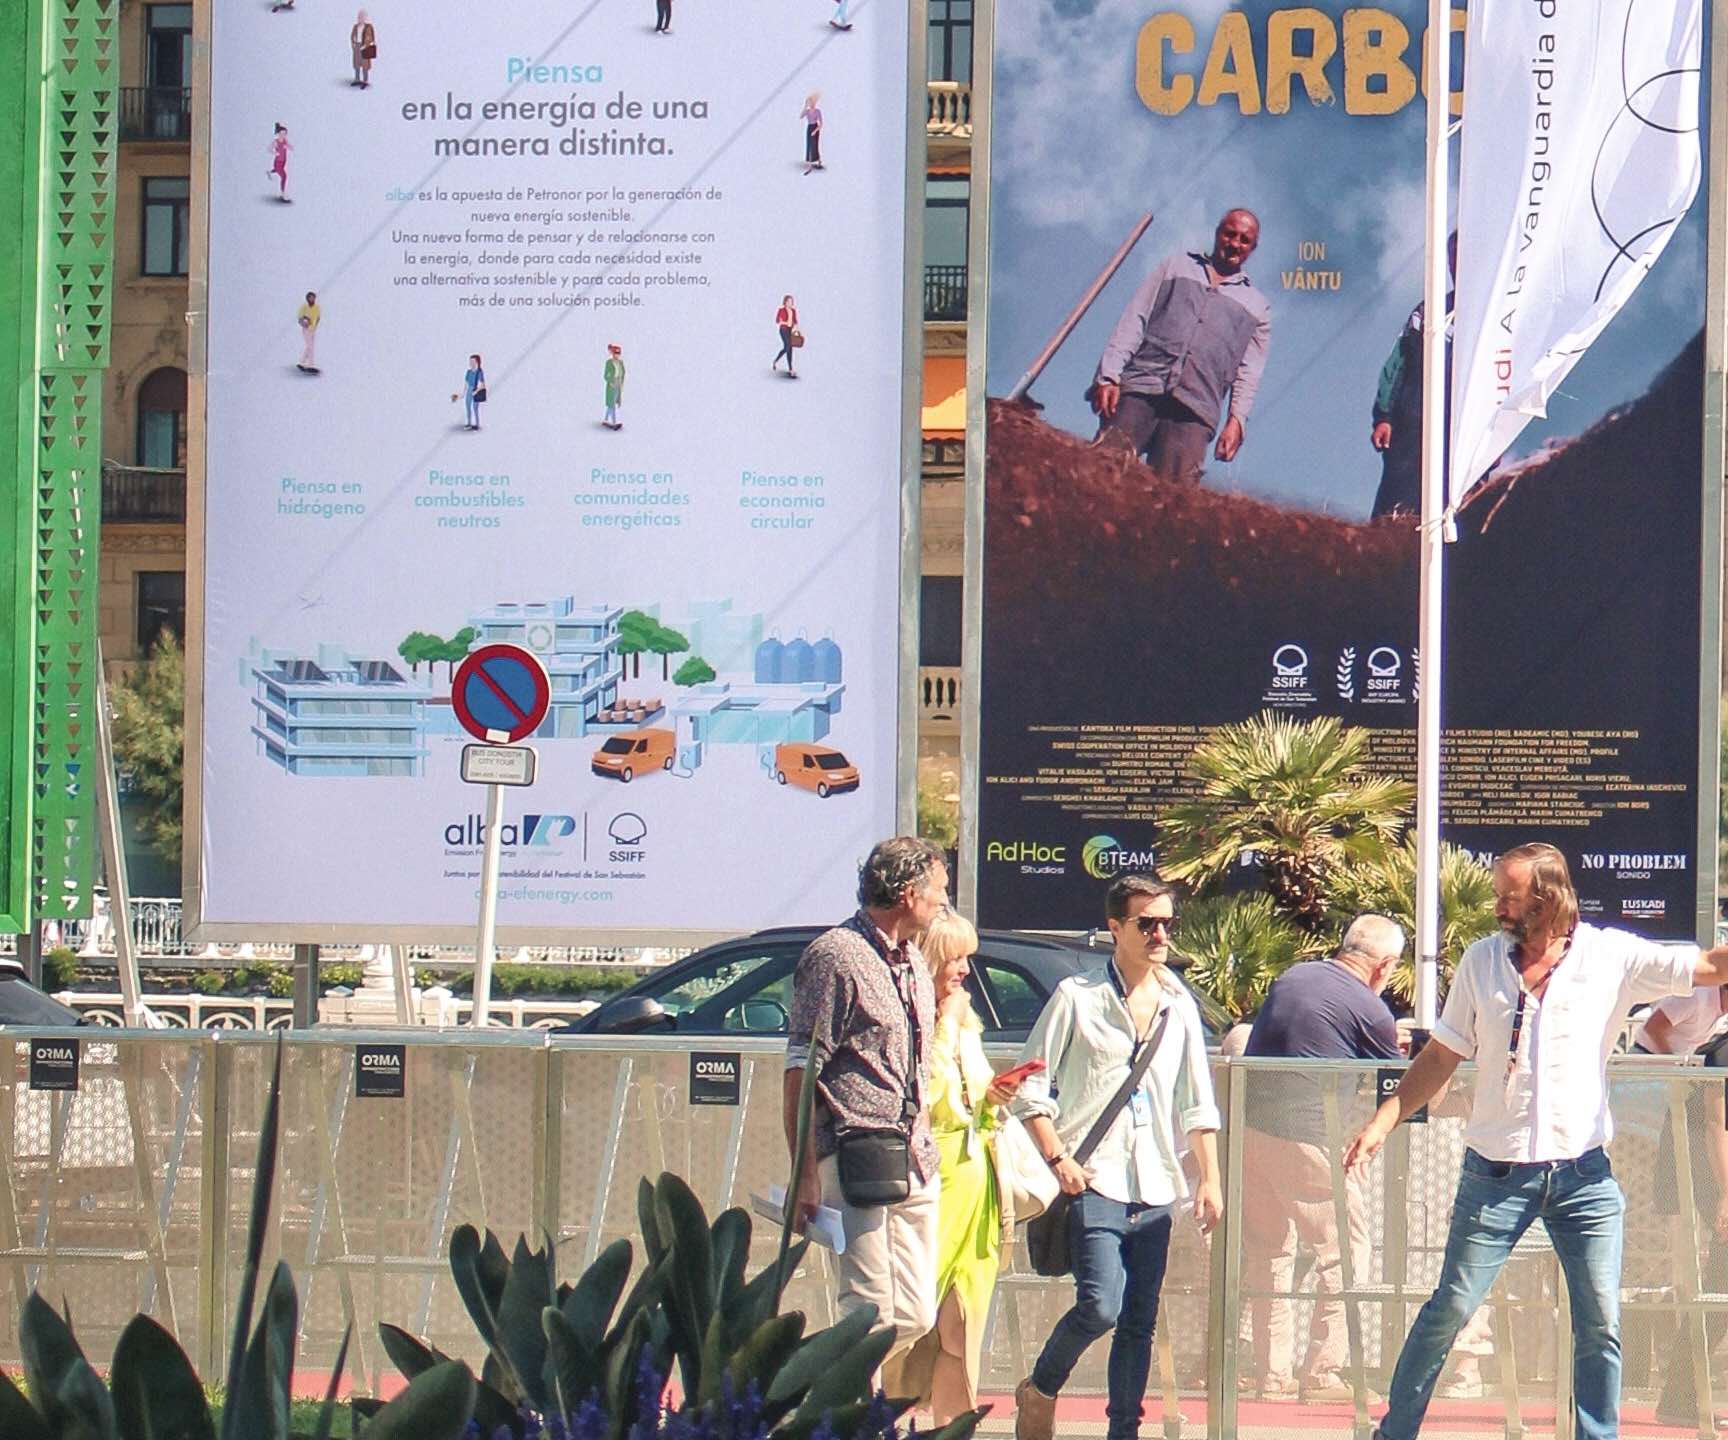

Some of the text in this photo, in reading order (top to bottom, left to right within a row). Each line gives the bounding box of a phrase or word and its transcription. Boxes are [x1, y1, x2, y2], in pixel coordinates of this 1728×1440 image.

[506, 56, 604, 85] Piensa
[401, 90, 709, 127] en la energía de una
[434, 127, 674, 158] manera distinta.
[1520, 34, 1557, 252] vanguardia
[418, 190, 433, 201] es
[435, 186, 448, 201] la
[451, 188, 503, 205] apuesta
[506, 185, 523, 201] de
[526, 187, 583, 201] Petronor
[586, 190, 609, 205] por
[612, 185, 625, 201] la
[628, 185, 702, 205] generación
[705, 185, 723, 201] de
[470, 212, 511, 223] nueva
[567, 207, 635, 223] sostenible.
[391, 228, 716, 247] Una nueva forma de pensar y de relacionarse con
[403, 249, 417, 265] la
[477, 249, 520, 265] donde
[523, 254, 555, 268] para
[557, 249, 592, 265] cada
[594, 249, 662, 265] necesidad
[664, 250, 702, 265] existe
[1298, 241, 1326, 261] ION
[393, 271, 711, 289] una alternativa sostenible y para cada problema,
[1280, 266, 1341, 290] VÂNTU
[1507, 265, 1527, 295] la
[458, 292, 645, 311] más de una solución posible.
[1500, 307, 1516, 334] A
[1495, 348, 1512, 405] udi
[279, 477, 362, 494] Piensa en
[428, 469, 511, 487] Piensa en
[590, 467, 673, 485] Piensa en
[741, 470, 825, 488] Piensa en
[414, 490, 525, 508] combustibles
[573, 487, 690, 506] comunidades
[277, 496, 366, 520] hidrógeno
[436, 513, 501, 529] neutros
[581, 510, 681, 530] energéticas
[750, 512, 815, 529] circular
[1272, 676, 1308, 688] SSIFF
[1367, 678, 1401, 690] SSIFF
[608, 850, 647, 863] SSIFF
[1097, 850, 1154, 866] BTEAM
[1582, 853, 1687, 870] NO PROBLEM
[1020, 864, 1065, 875] Studios
[474, 884, 613, 903] aa-efenergy.com
[1621, 899, 1666, 909] EUSKADI
